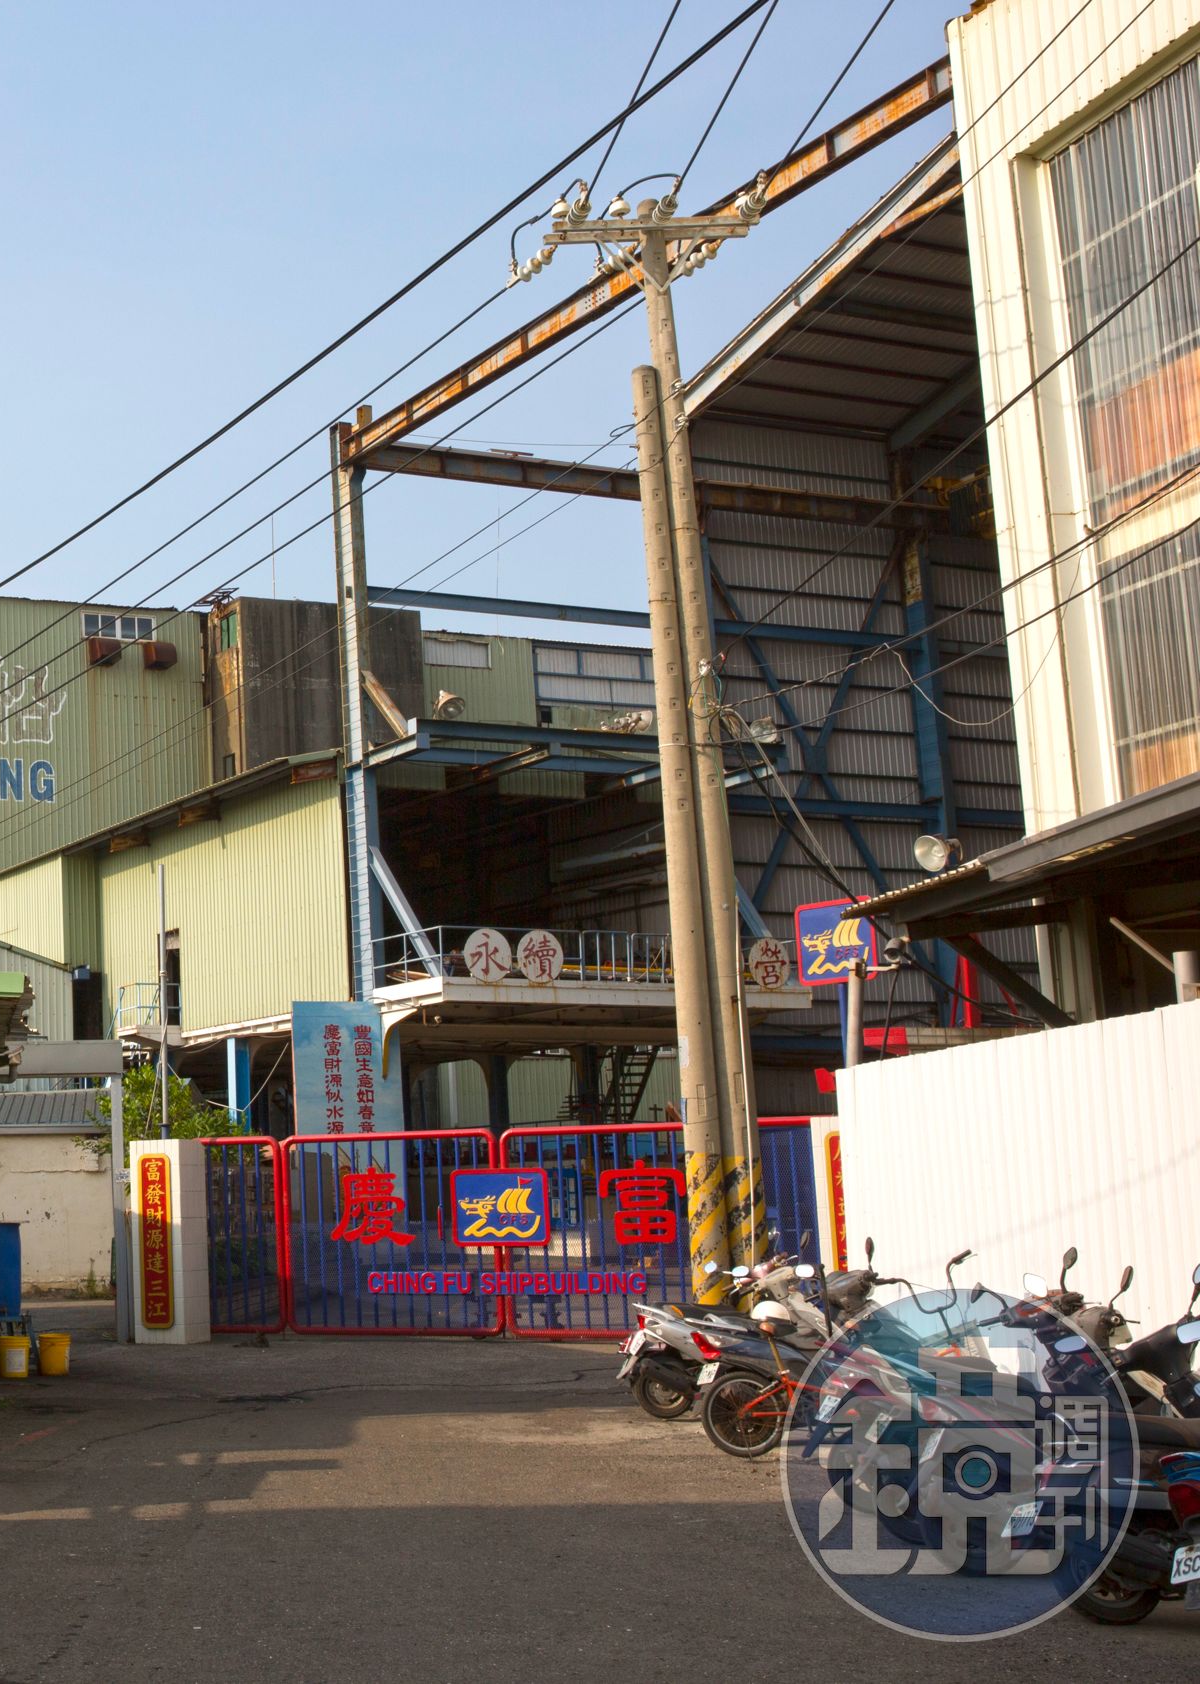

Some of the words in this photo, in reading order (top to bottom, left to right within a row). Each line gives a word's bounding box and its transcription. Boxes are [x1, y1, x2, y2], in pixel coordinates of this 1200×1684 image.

[469, 932, 554, 980] 永續
[754, 940, 787, 986] 營
[144, 1158, 167, 1318] 富發財源達三江
[331, 1166, 417, 1247] 慶
[600, 1159, 687, 1245] 富
[367, 1271, 437, 1294] CHING
[443, 1271, 472, 1293] FU
[481, 1271, 647, 1294] SHIPBUILDING
